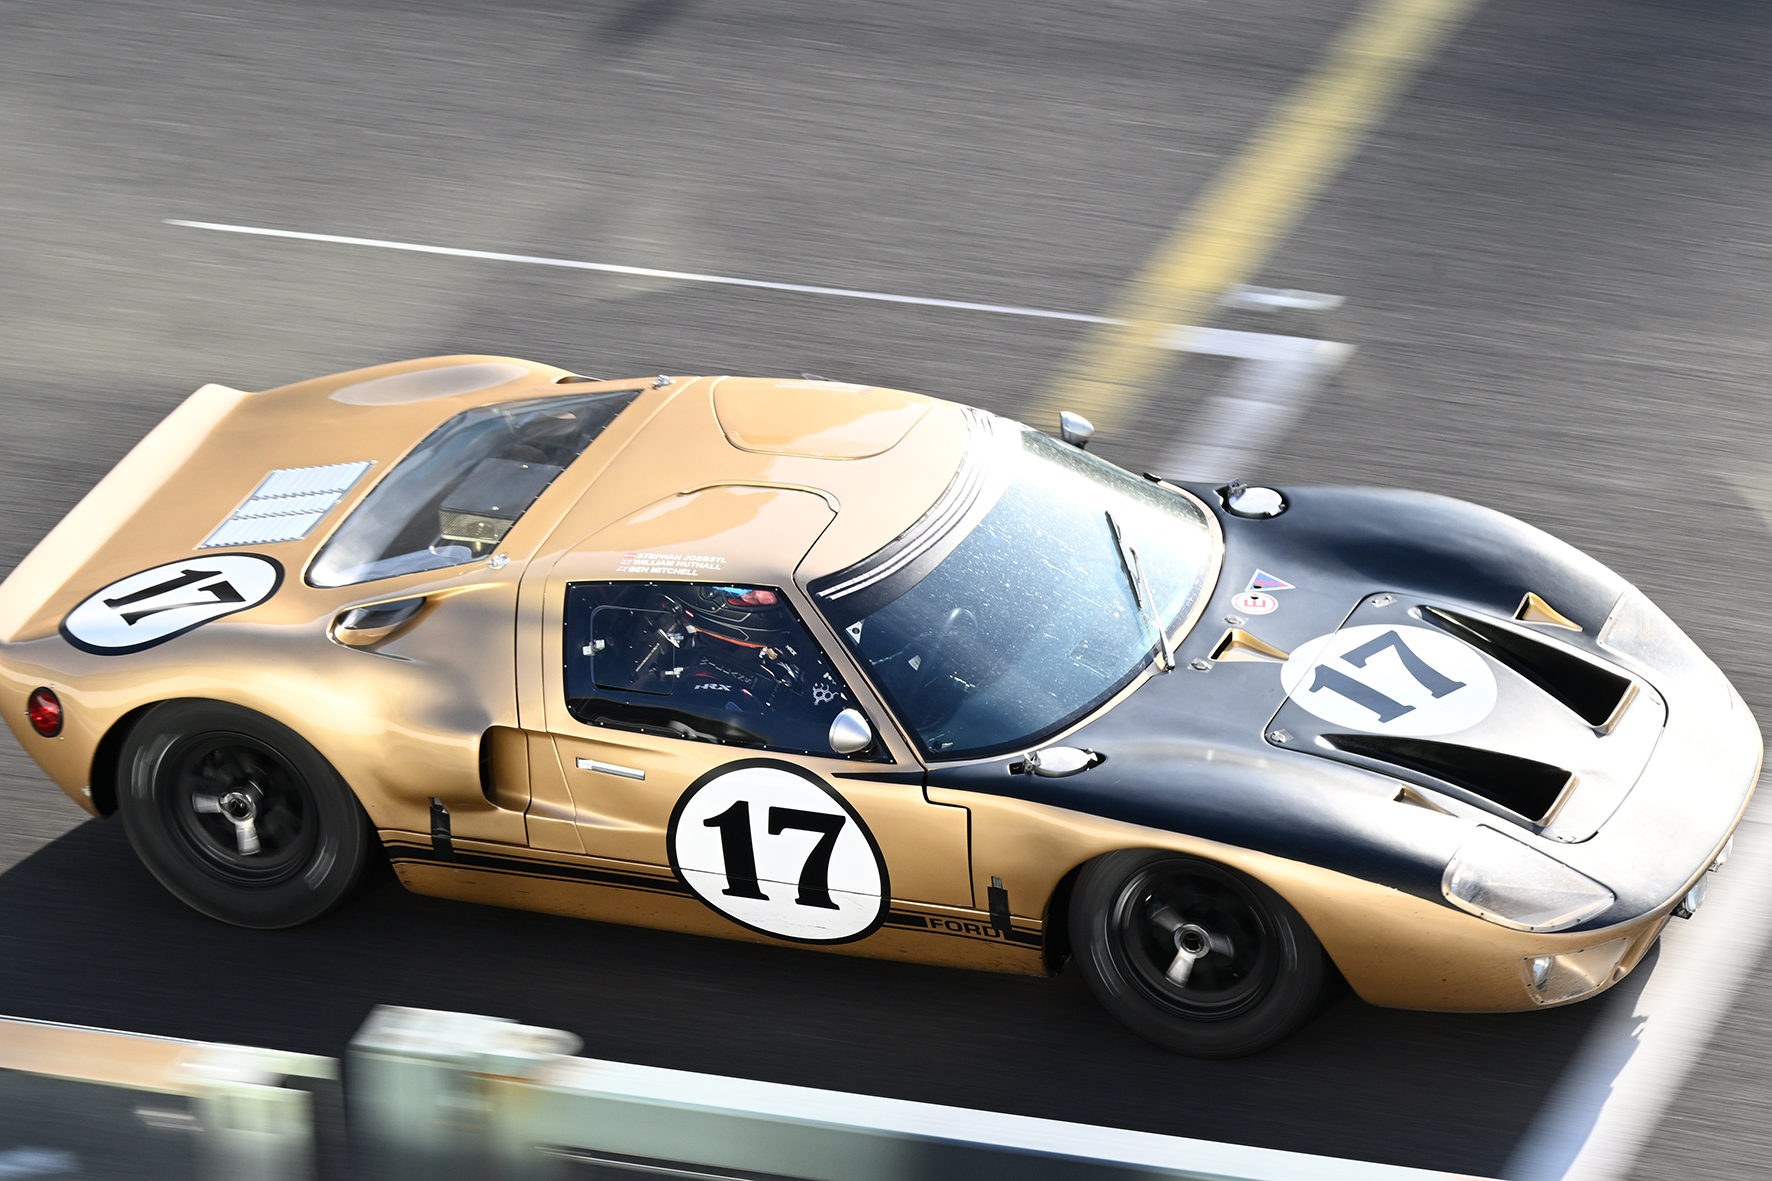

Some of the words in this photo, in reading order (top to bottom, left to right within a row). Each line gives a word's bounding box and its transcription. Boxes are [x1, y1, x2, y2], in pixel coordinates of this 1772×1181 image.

[637, 553, 682, 561] STEPHAN
[633, 559, 675, 567] WILLIAM
[676, 561, 722, 570] NUTHALL
[650, 567, 698, 576] MITCHELL
[102, 569, 247, 626] 17
[1244, 599, 1266, 608] E
[1308, 630, 1467, 723] 17
[694, 683, 732, 692] HRX
[703, 800, 846, 911] 17
[929, 918, 1001, 938] FORD
